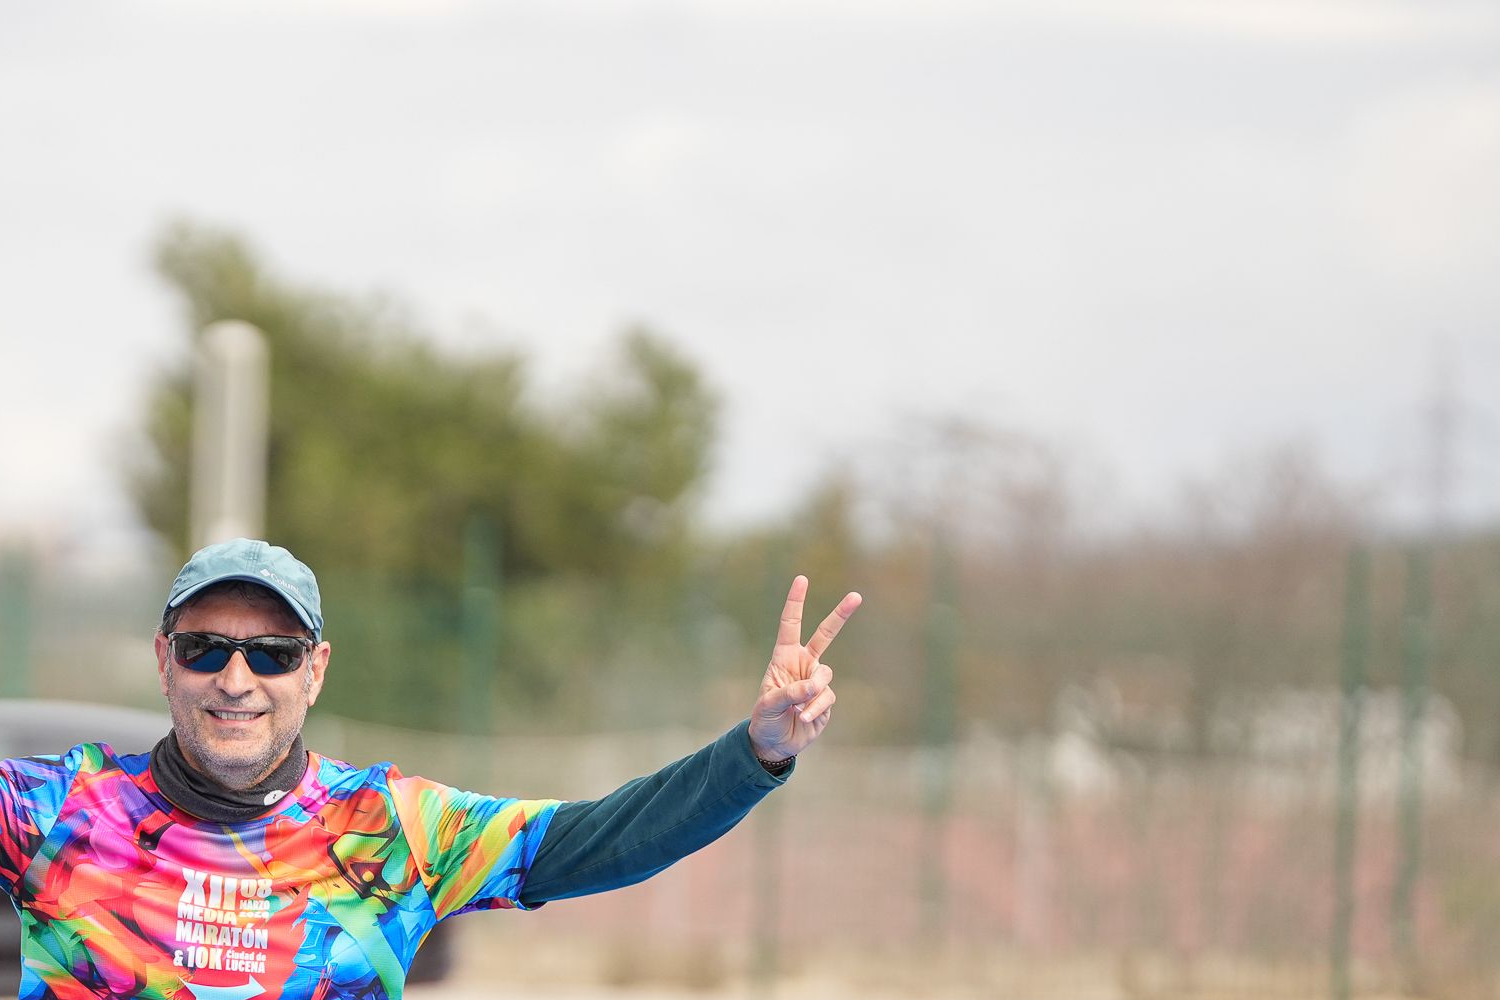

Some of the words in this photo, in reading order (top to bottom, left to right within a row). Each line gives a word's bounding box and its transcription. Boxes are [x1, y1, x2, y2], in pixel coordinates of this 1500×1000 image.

[179, 867, 238, 910] XII
[241, 879, 273, 898] 08
[178, 902, 237, 925] MEDIA
[240, 899, 270, 910] MARZO
[176, 920, 268, 949] MARATÓN
[173, 950, 184, 967] &
[187, 946, 223, 970] 10K
[226, 949, 254, 961] Ciudad
[256, 952, 266, 961] de
[226, 959, 266, 973] LUCENA
